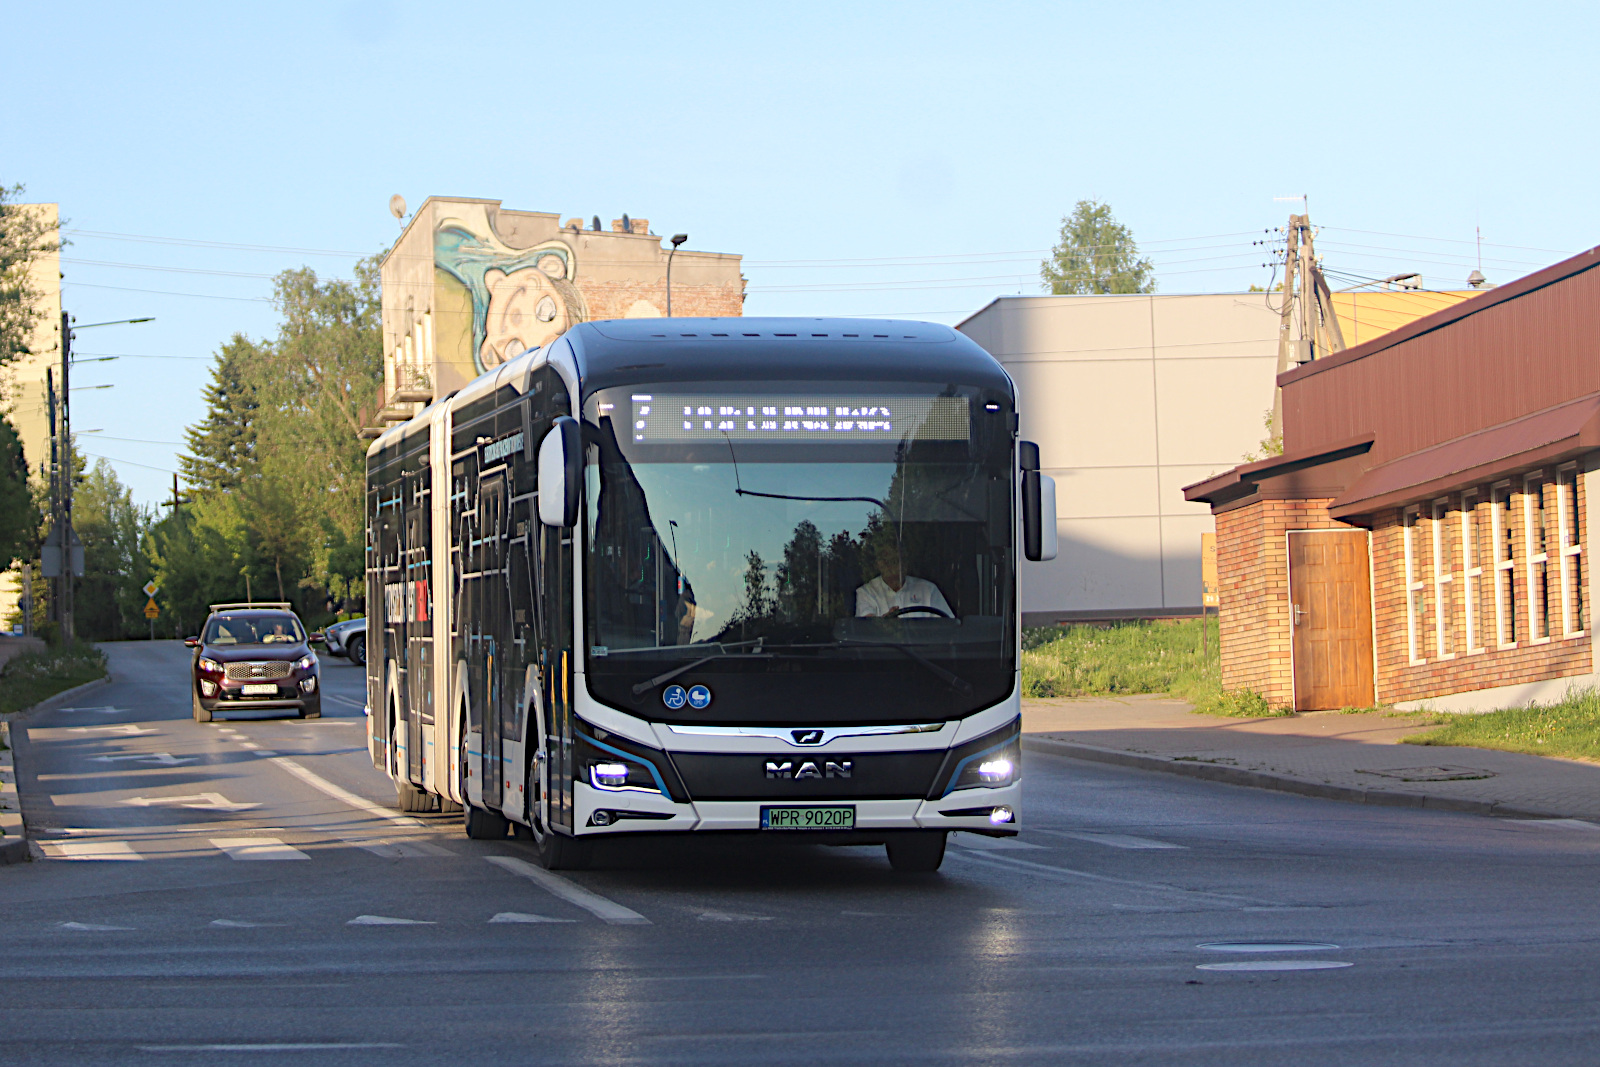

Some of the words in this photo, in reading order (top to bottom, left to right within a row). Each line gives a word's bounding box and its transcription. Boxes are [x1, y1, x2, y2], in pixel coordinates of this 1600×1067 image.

[766, 762, 851, 778] MAN
[771, 811, 799, 825] WPR
[805, 811, 852, 825] 9020P
